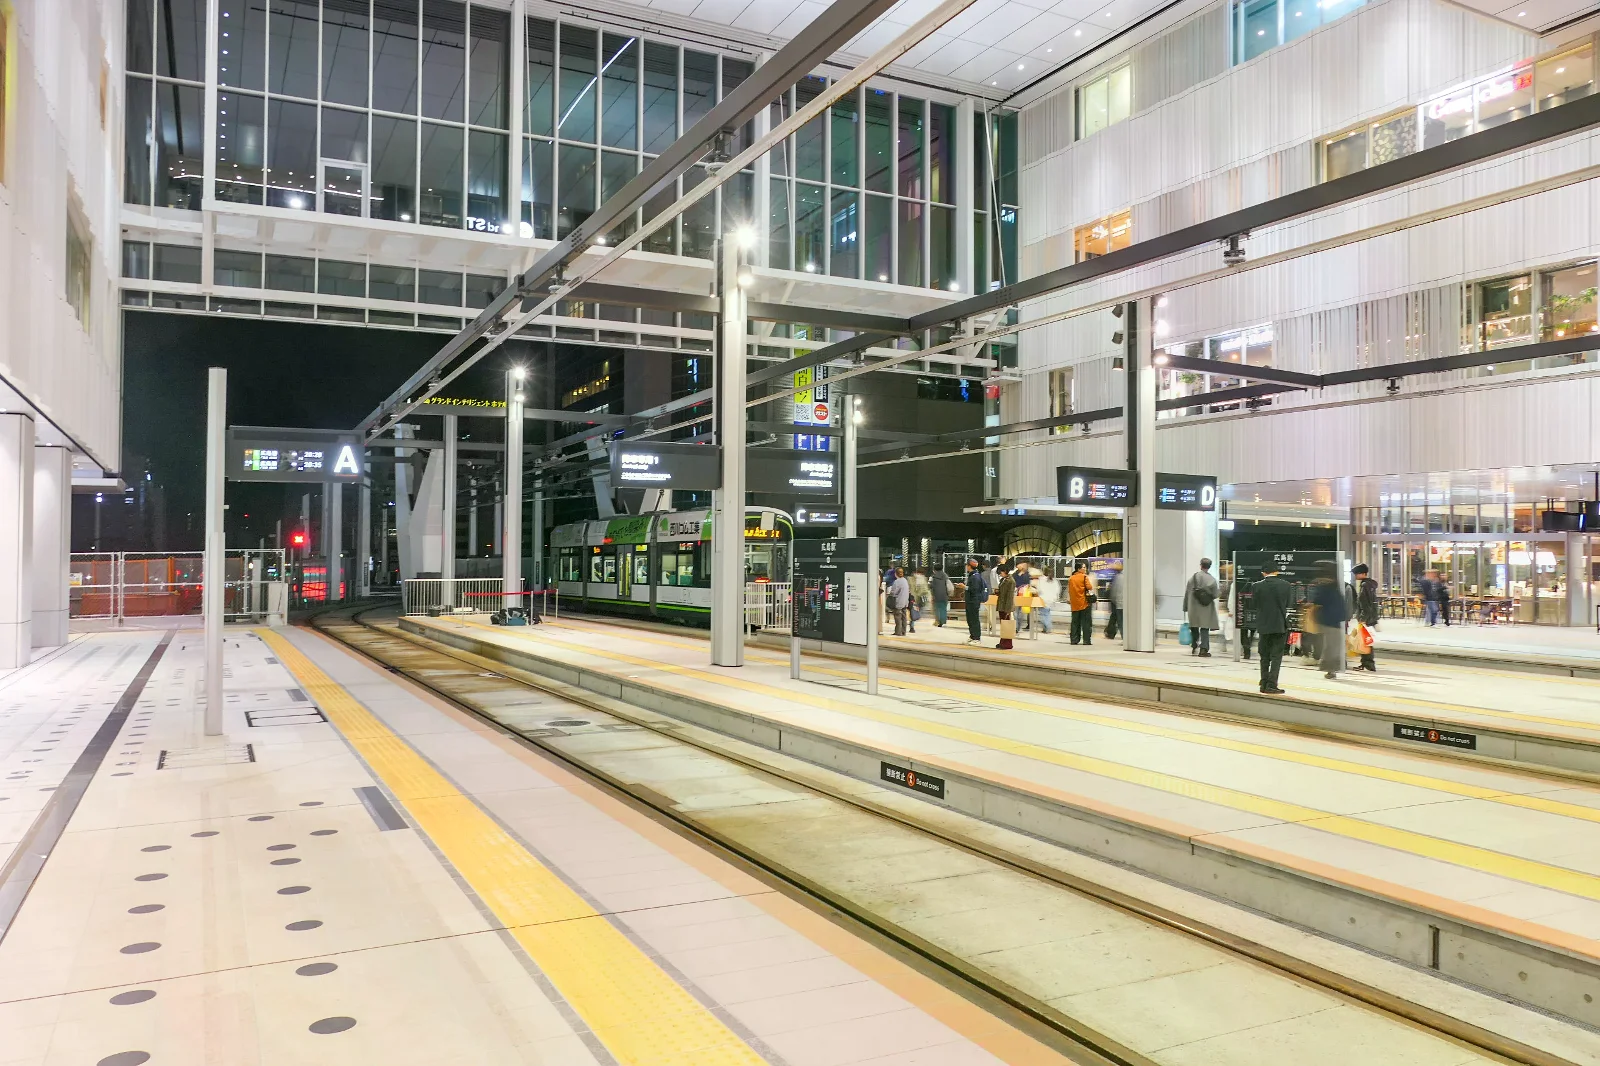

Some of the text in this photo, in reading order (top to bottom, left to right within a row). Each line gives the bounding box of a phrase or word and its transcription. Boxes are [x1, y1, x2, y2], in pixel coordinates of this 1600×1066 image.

[333, 445, 359, 473] A
[1069, 477, 1084, 498] B
[1201, 485, 1214, 506] D
[796, 509, 807, 523] C
